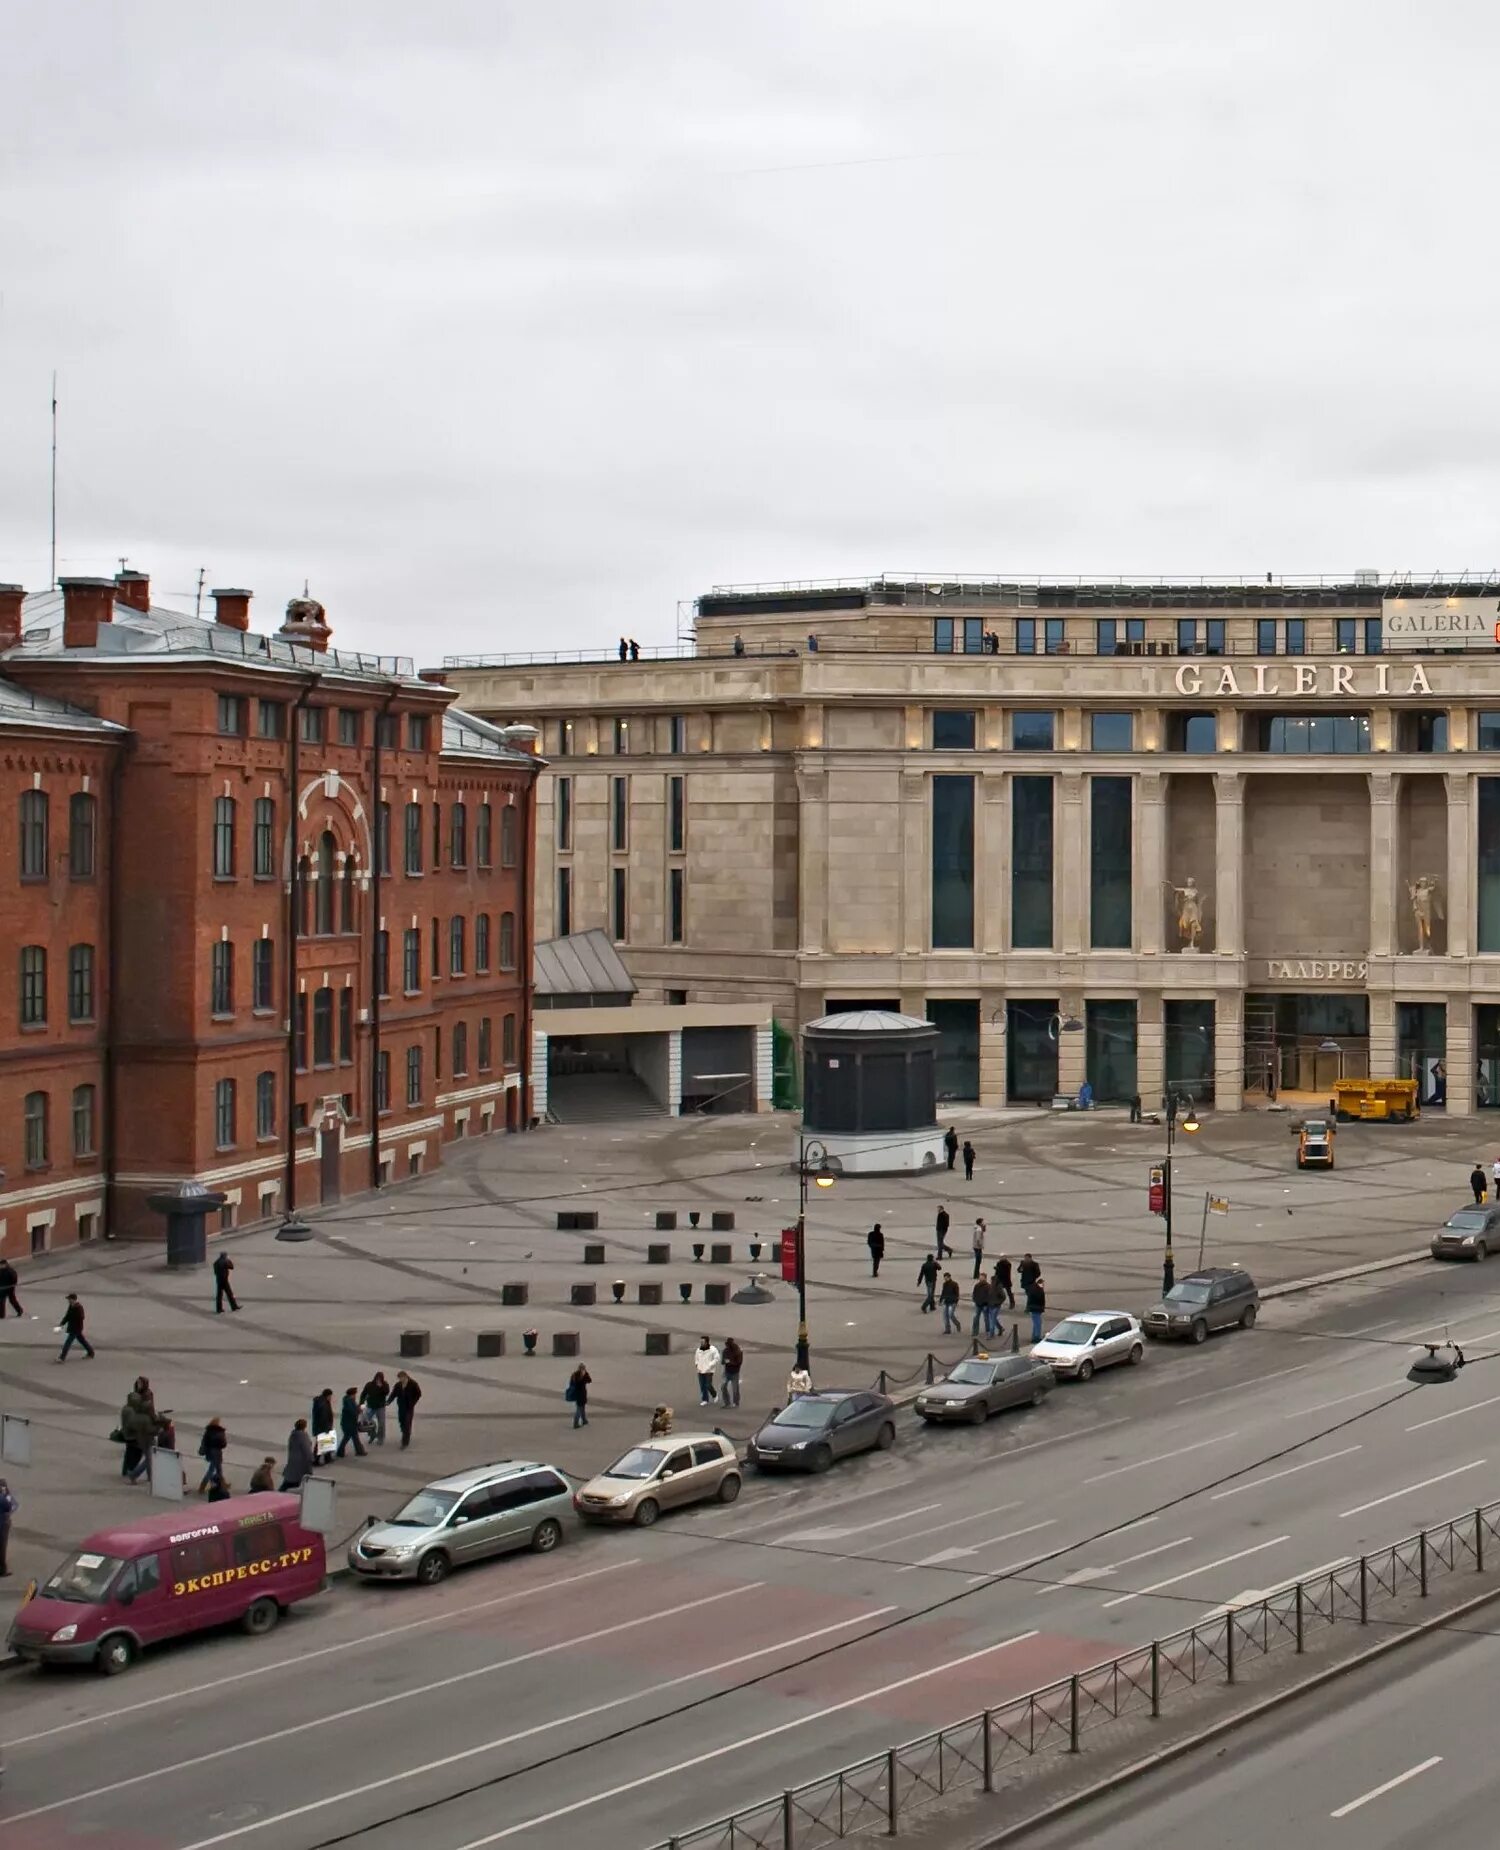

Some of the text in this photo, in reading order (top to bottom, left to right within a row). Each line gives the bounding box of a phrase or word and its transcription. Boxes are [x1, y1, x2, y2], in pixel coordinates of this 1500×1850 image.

[1388, 614, 1487, 633] GALERIA
[1175, 663, 1434, 696] GALERIA
[1267, 959, 1368, 980] ГАЛЕРЕЯ
[238, 1511, 274, 1528] ЭЛИСТА
[169, 1525, 220, 1543] ВОЛГОГРАД
[174, 1547, 312, 1596] ЭКСПРЕСС-ТУР
